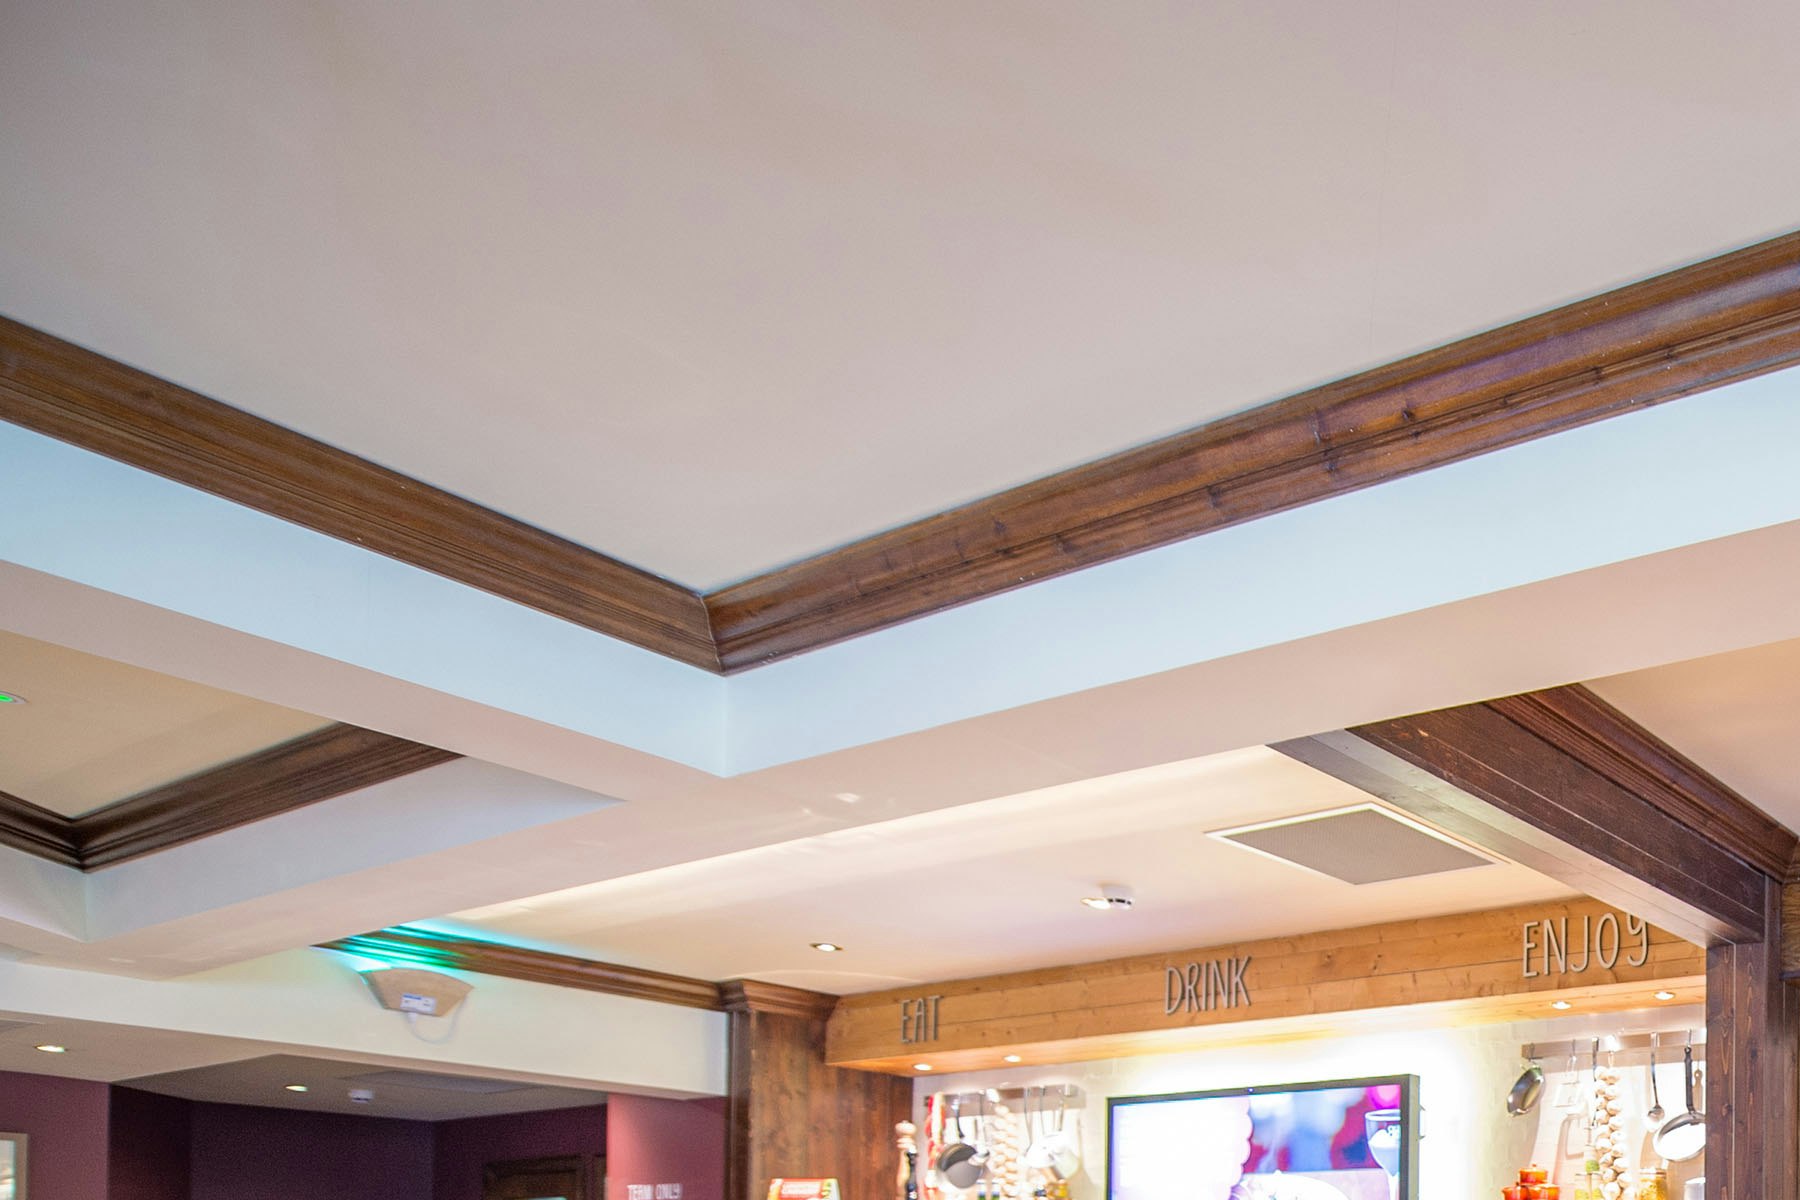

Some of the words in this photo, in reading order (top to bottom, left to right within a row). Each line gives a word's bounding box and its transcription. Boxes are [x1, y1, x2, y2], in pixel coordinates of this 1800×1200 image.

[1523, 912, 1649, 978] ENJOY
[1164, 955, 1252, 1015] DRINK
[901, 995, 944, 1043] EAT
